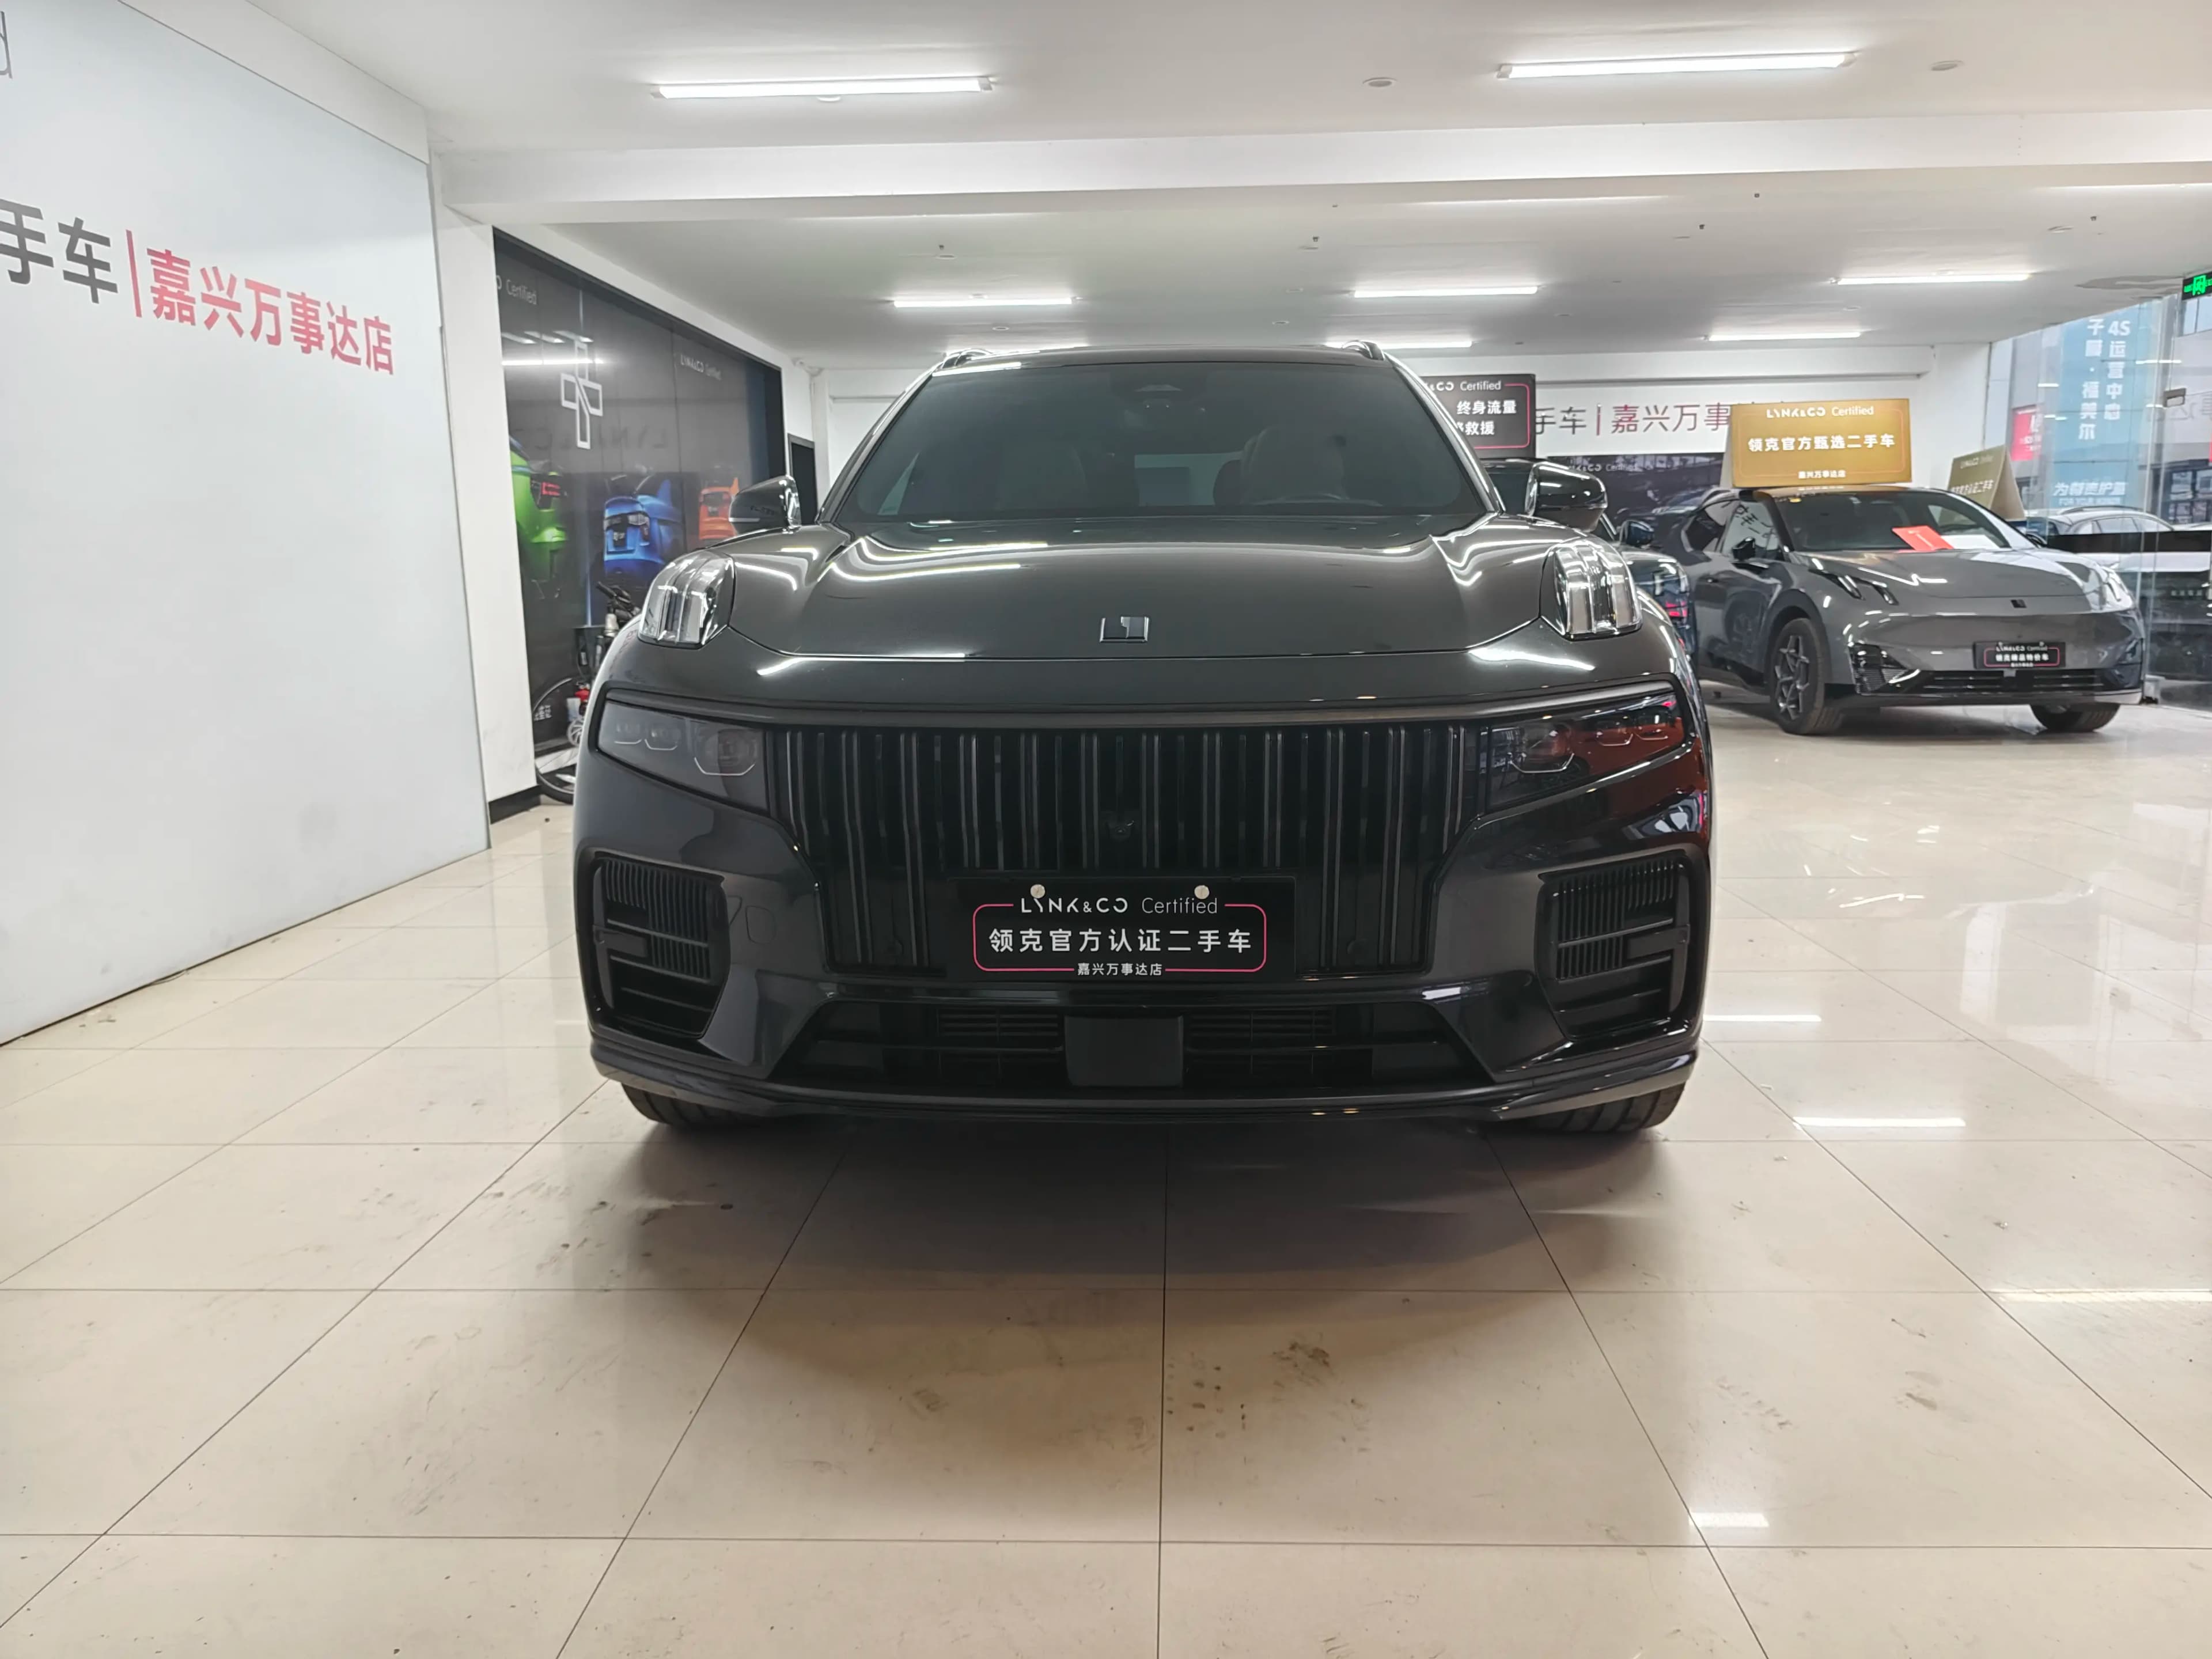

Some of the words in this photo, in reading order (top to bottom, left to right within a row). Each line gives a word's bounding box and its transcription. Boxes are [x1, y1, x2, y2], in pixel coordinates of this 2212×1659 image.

[146, 248, 394, 376] 嘉兴万事达店
[1460, 380, 1502, 391] Certified
[1456, 400, 1517, 415] 终身流量
[1831, 406, 1874, 417] Certified
[1748, 433, 1896, 452] 领克官方甄选二手车
[1141, 897, 1218, 914] Certified
[988, 928, 1252, 953] 领克官方认证二手车
[1077, 963, 1162, 976] 嘉兴万事达店
